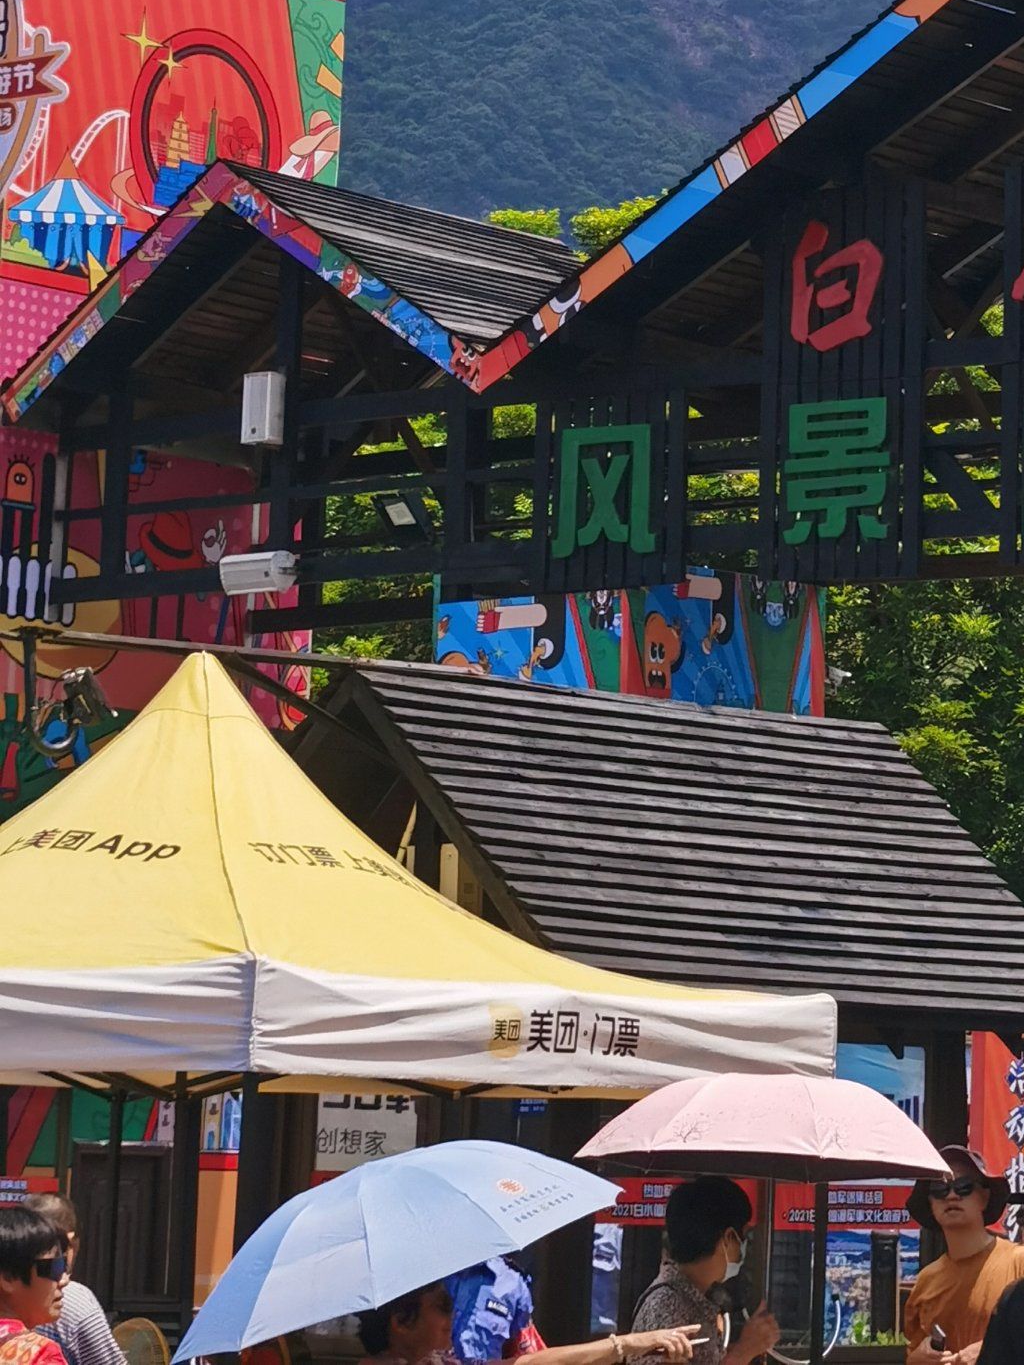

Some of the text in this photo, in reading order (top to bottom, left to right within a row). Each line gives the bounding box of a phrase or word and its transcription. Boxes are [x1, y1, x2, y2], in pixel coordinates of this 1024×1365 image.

[86, 834, 182, 862] App
[493, 1019, 521, 1041] 美团
[317, 1127, 387, 1156] 创想家
